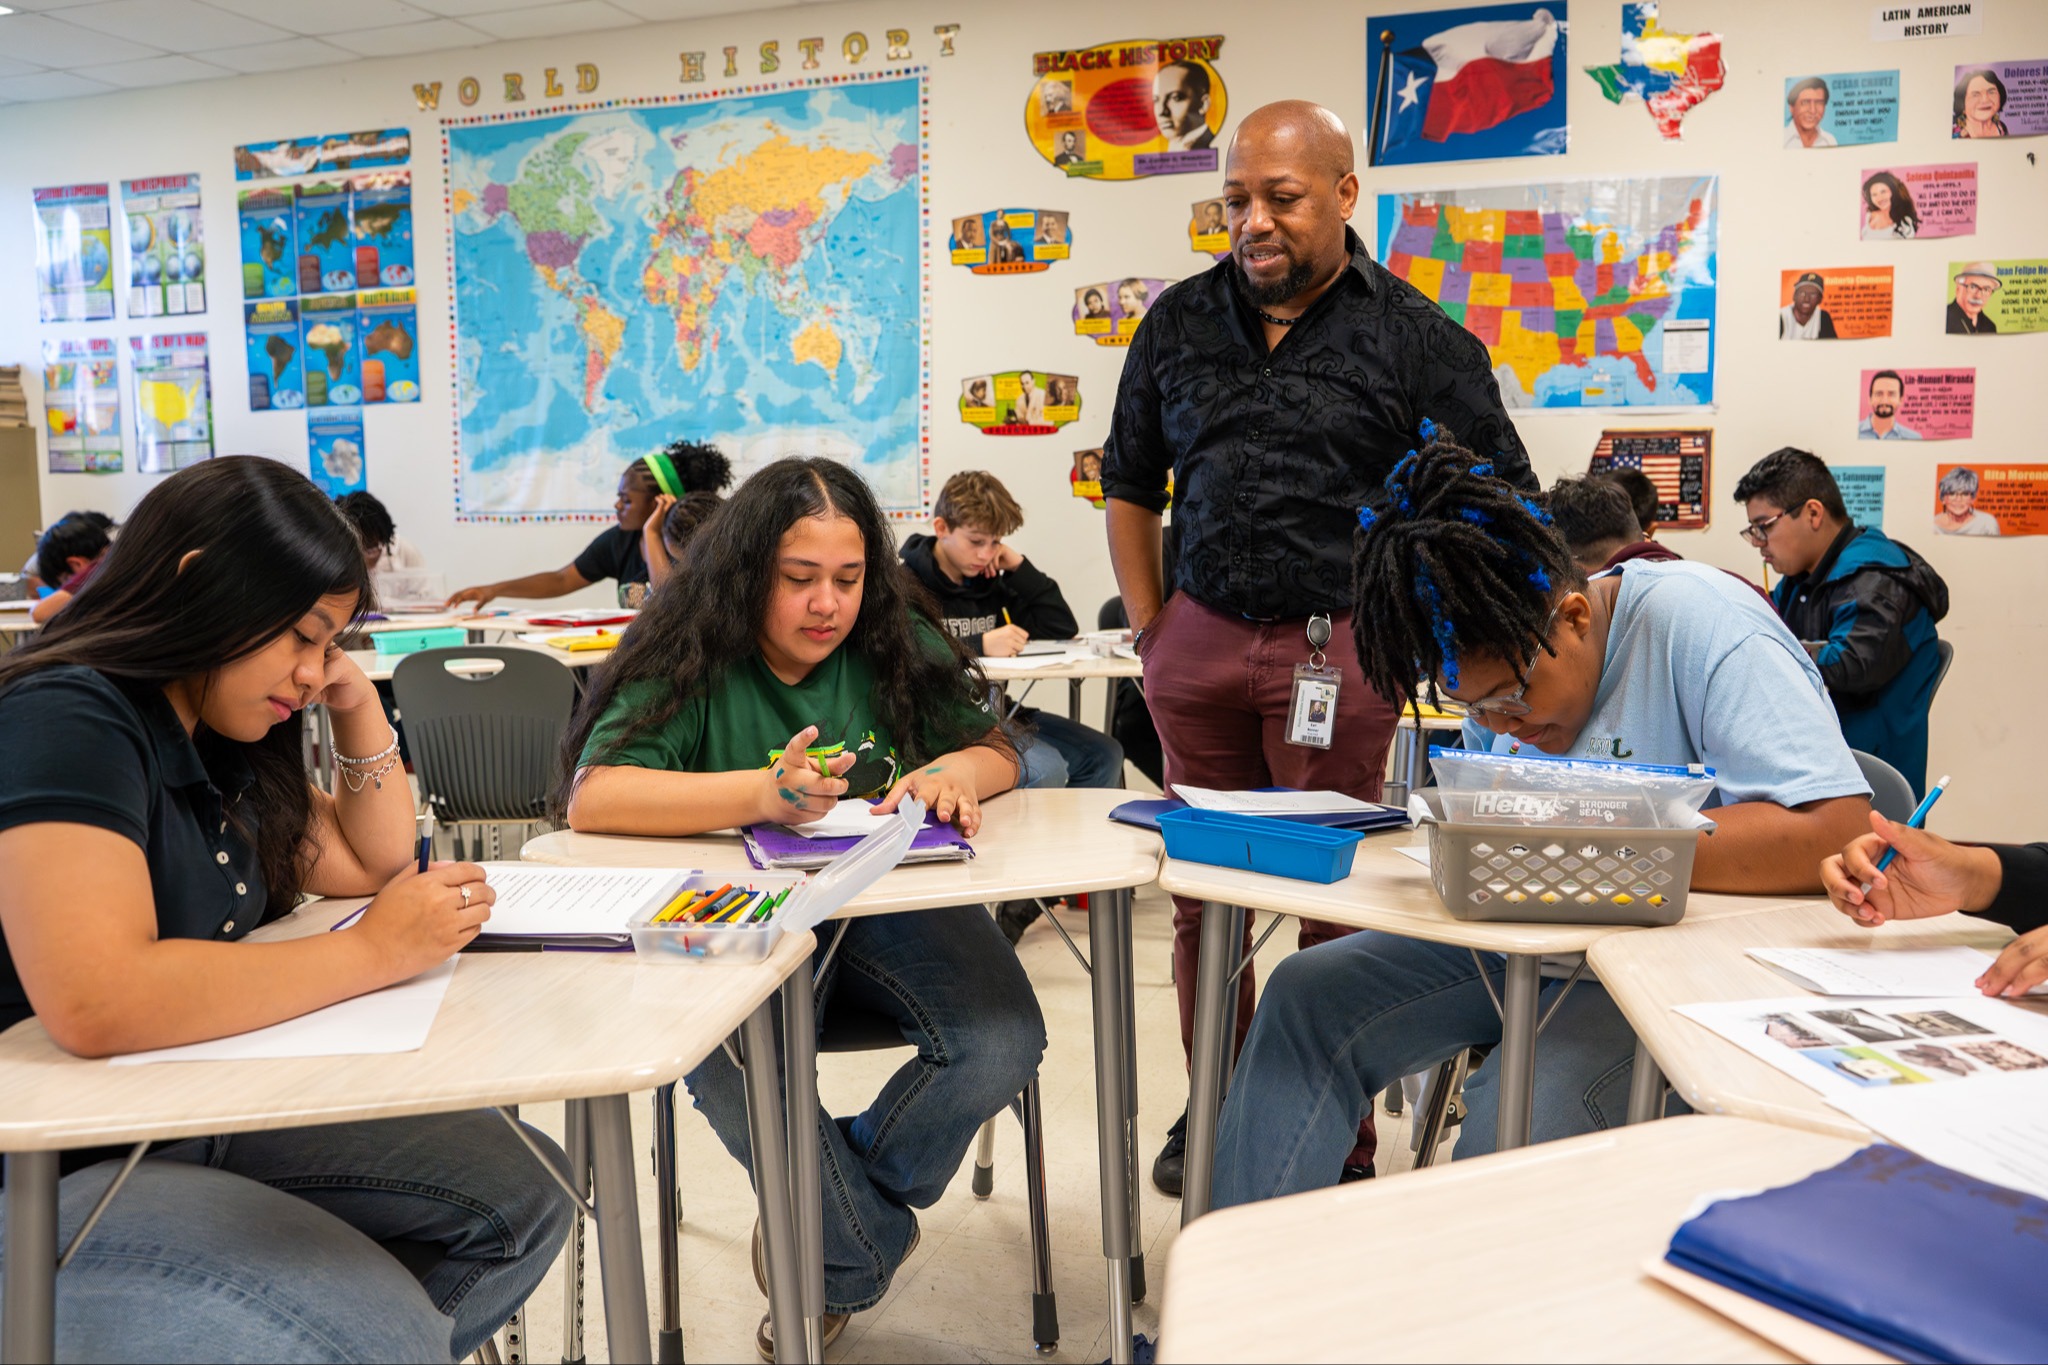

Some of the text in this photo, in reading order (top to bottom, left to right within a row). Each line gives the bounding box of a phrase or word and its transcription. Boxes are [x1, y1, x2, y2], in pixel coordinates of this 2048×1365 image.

[1882, 4, 1971, 22] LATIN AMERICAN
[1904, 23, 1949, 37] HISTORY
[1035, 37, 1223, 74] BLACK HISTORY
[413, 24, 961, 112] WORLD HISTORY
[2004, 67, 2041, 78] Dolores
[1832, 76, 1893, 90] CESAR CHAVEZ
[1906, 170, 1975, 182] Selena Quintanilla
[1997, 267, 2013, 276] Juan
[2015, 265, 2036, 275] Felipe
[1904, 374, 1974, 385] Lin-Manuel Miranda
[1984, 469, 2006, 481] Rita
[1477, 794, 1551, 816] Hefty
[1579, 800, 1628, 810] STRONGER
[1579, 808, 1602, 817] SEAL
